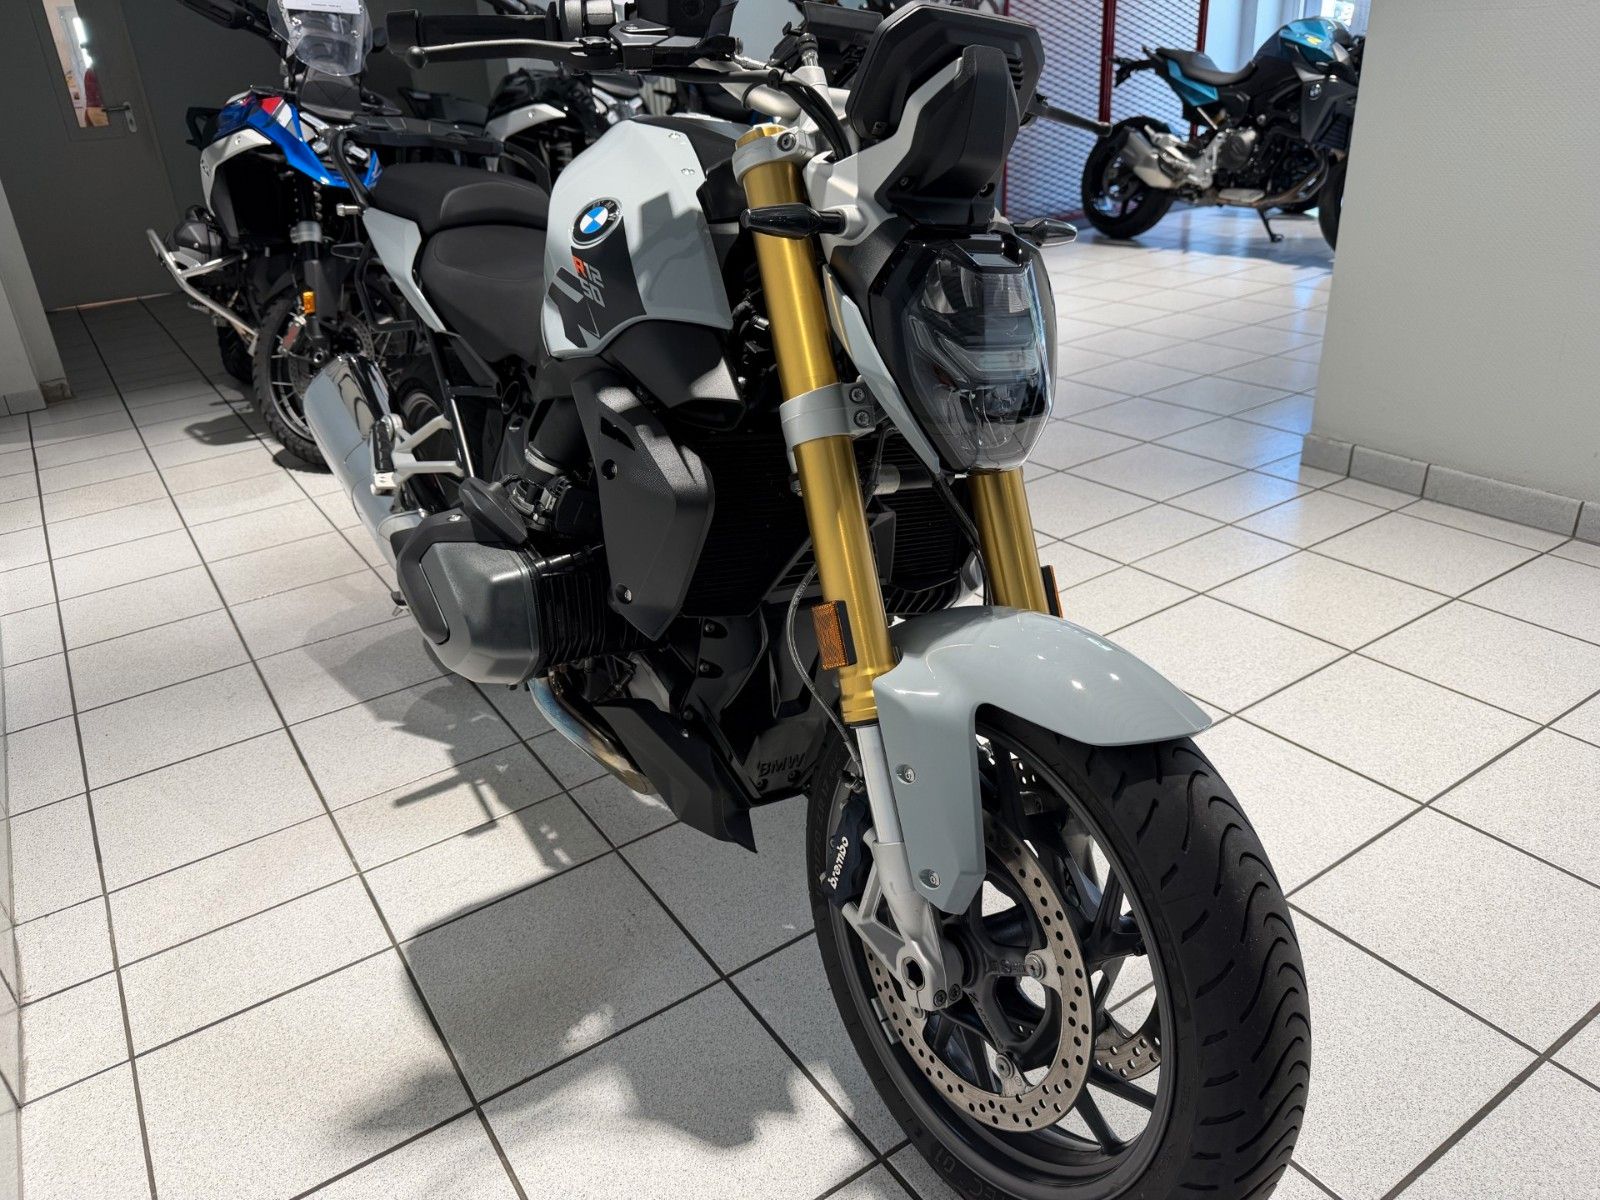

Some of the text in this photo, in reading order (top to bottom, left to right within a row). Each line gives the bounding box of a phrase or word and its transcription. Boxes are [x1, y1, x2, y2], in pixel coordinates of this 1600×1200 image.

[592, 200, 619, 221] BMW
[757, 752, 805, 777] BMW
[827, 836, 849, 890] brembo
